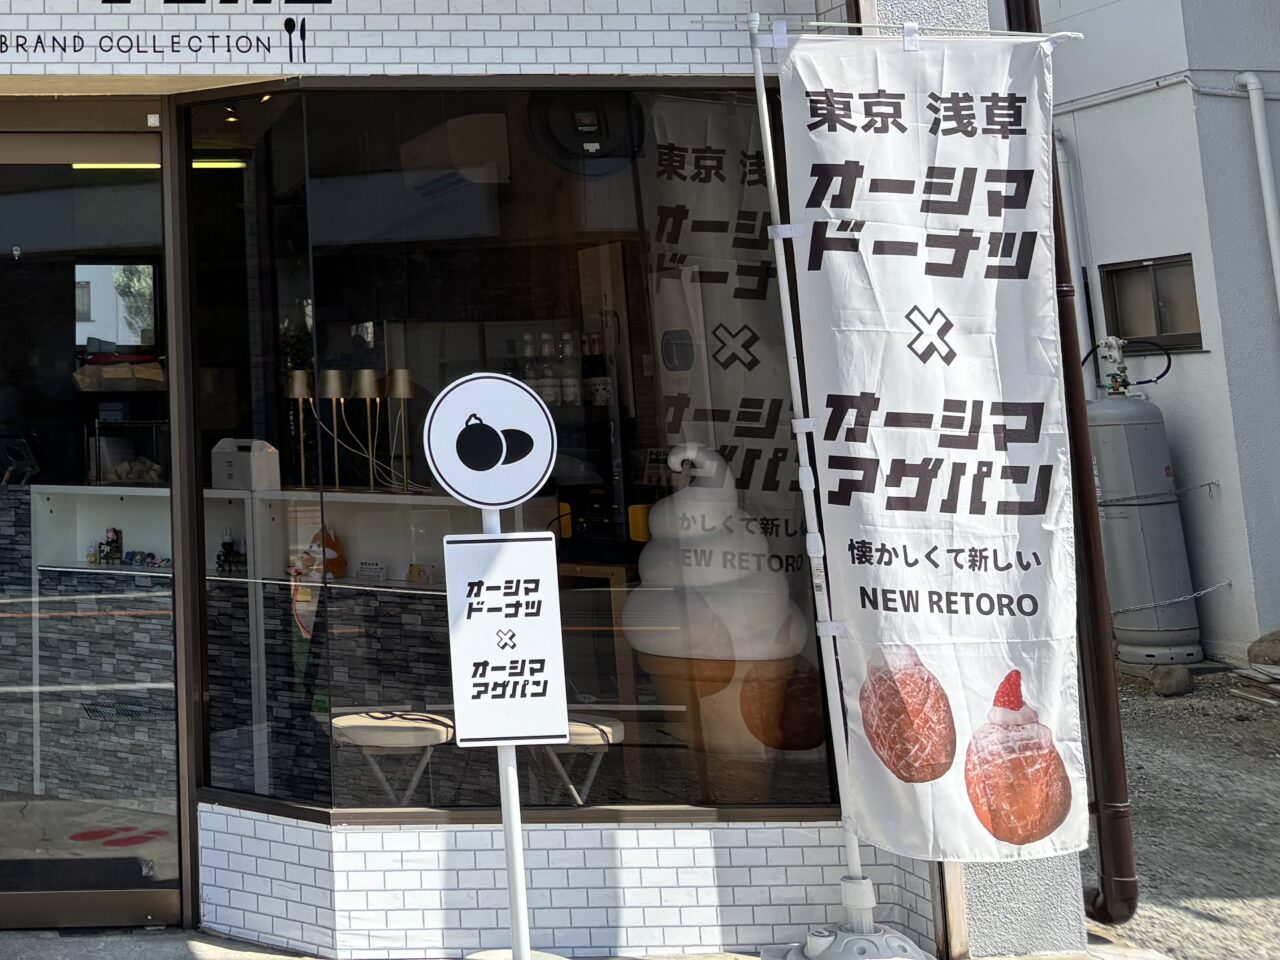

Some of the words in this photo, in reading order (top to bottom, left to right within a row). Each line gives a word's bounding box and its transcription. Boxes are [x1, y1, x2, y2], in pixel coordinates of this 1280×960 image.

[0, 34, 85, 54] BRAND
[98, 34, 271, 54] COLLECTION
[804, 88, 908, 134] 東京
[926, 91, 1027, 140] 浅草
[656, 142, 727, 183] 東京
[804, 159, 1035, 217] オーシマ
[807, 221, 1038, 280] ドーナツ
[822, 391, 1045, 451] オーシマ
[827, 454, 1054, 516] アゲパン
[847, 538, 1042, 573] 懐かしくて新しい
[466, 578, 540, 599] オーシマ
[859, 585, 919, 614] NEW
[928, 590, 1039, 617] RETORO
[466, 600, 542, 620] ドーナツ
[471, 658, 546, 678] オーシマ
[471, 679, 548, 700] アゲパン
